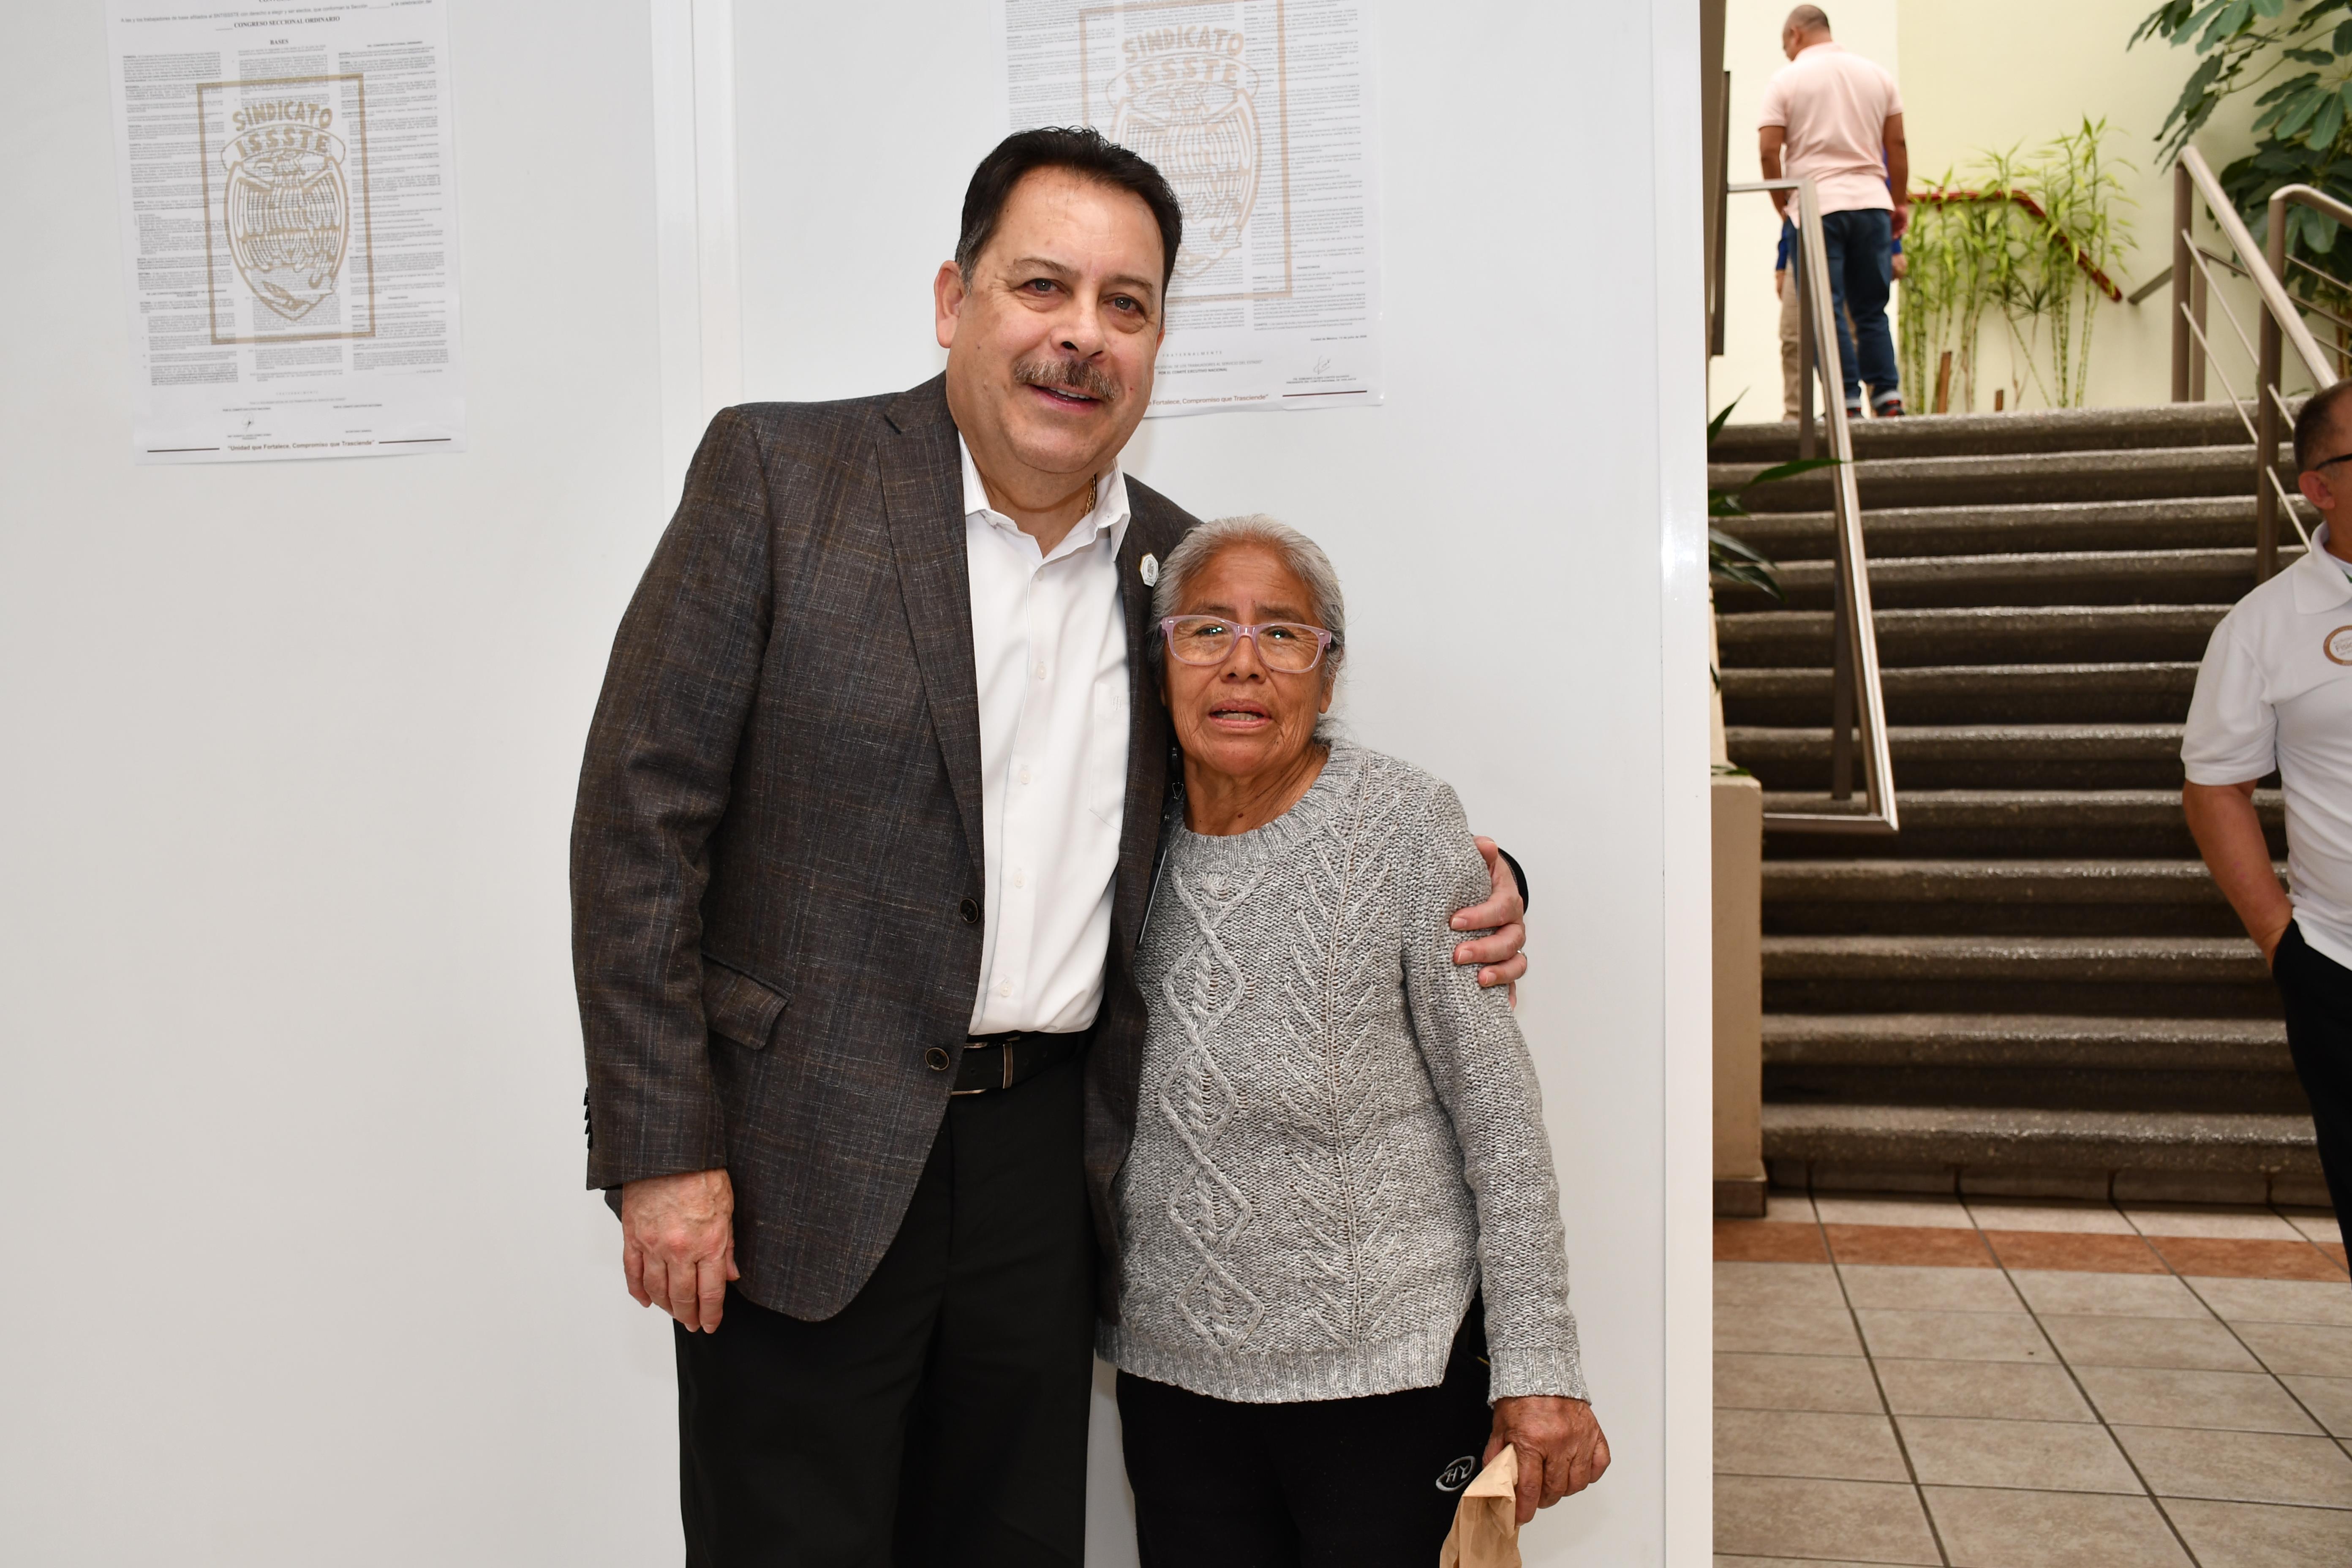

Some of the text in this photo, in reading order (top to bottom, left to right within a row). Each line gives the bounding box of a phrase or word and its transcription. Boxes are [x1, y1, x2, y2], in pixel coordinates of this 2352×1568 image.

[269, 18, 303, 26] SECCIONAL
[1122, 25, 1244, 63] SINDICATO
[1124, 57, 1240, 94] ISSSTE
[233, 100, 333, 131] SINDICATO
[235, 128, 330, 159] ISSSTE
[292, 441, 328, 449] Compromiso
